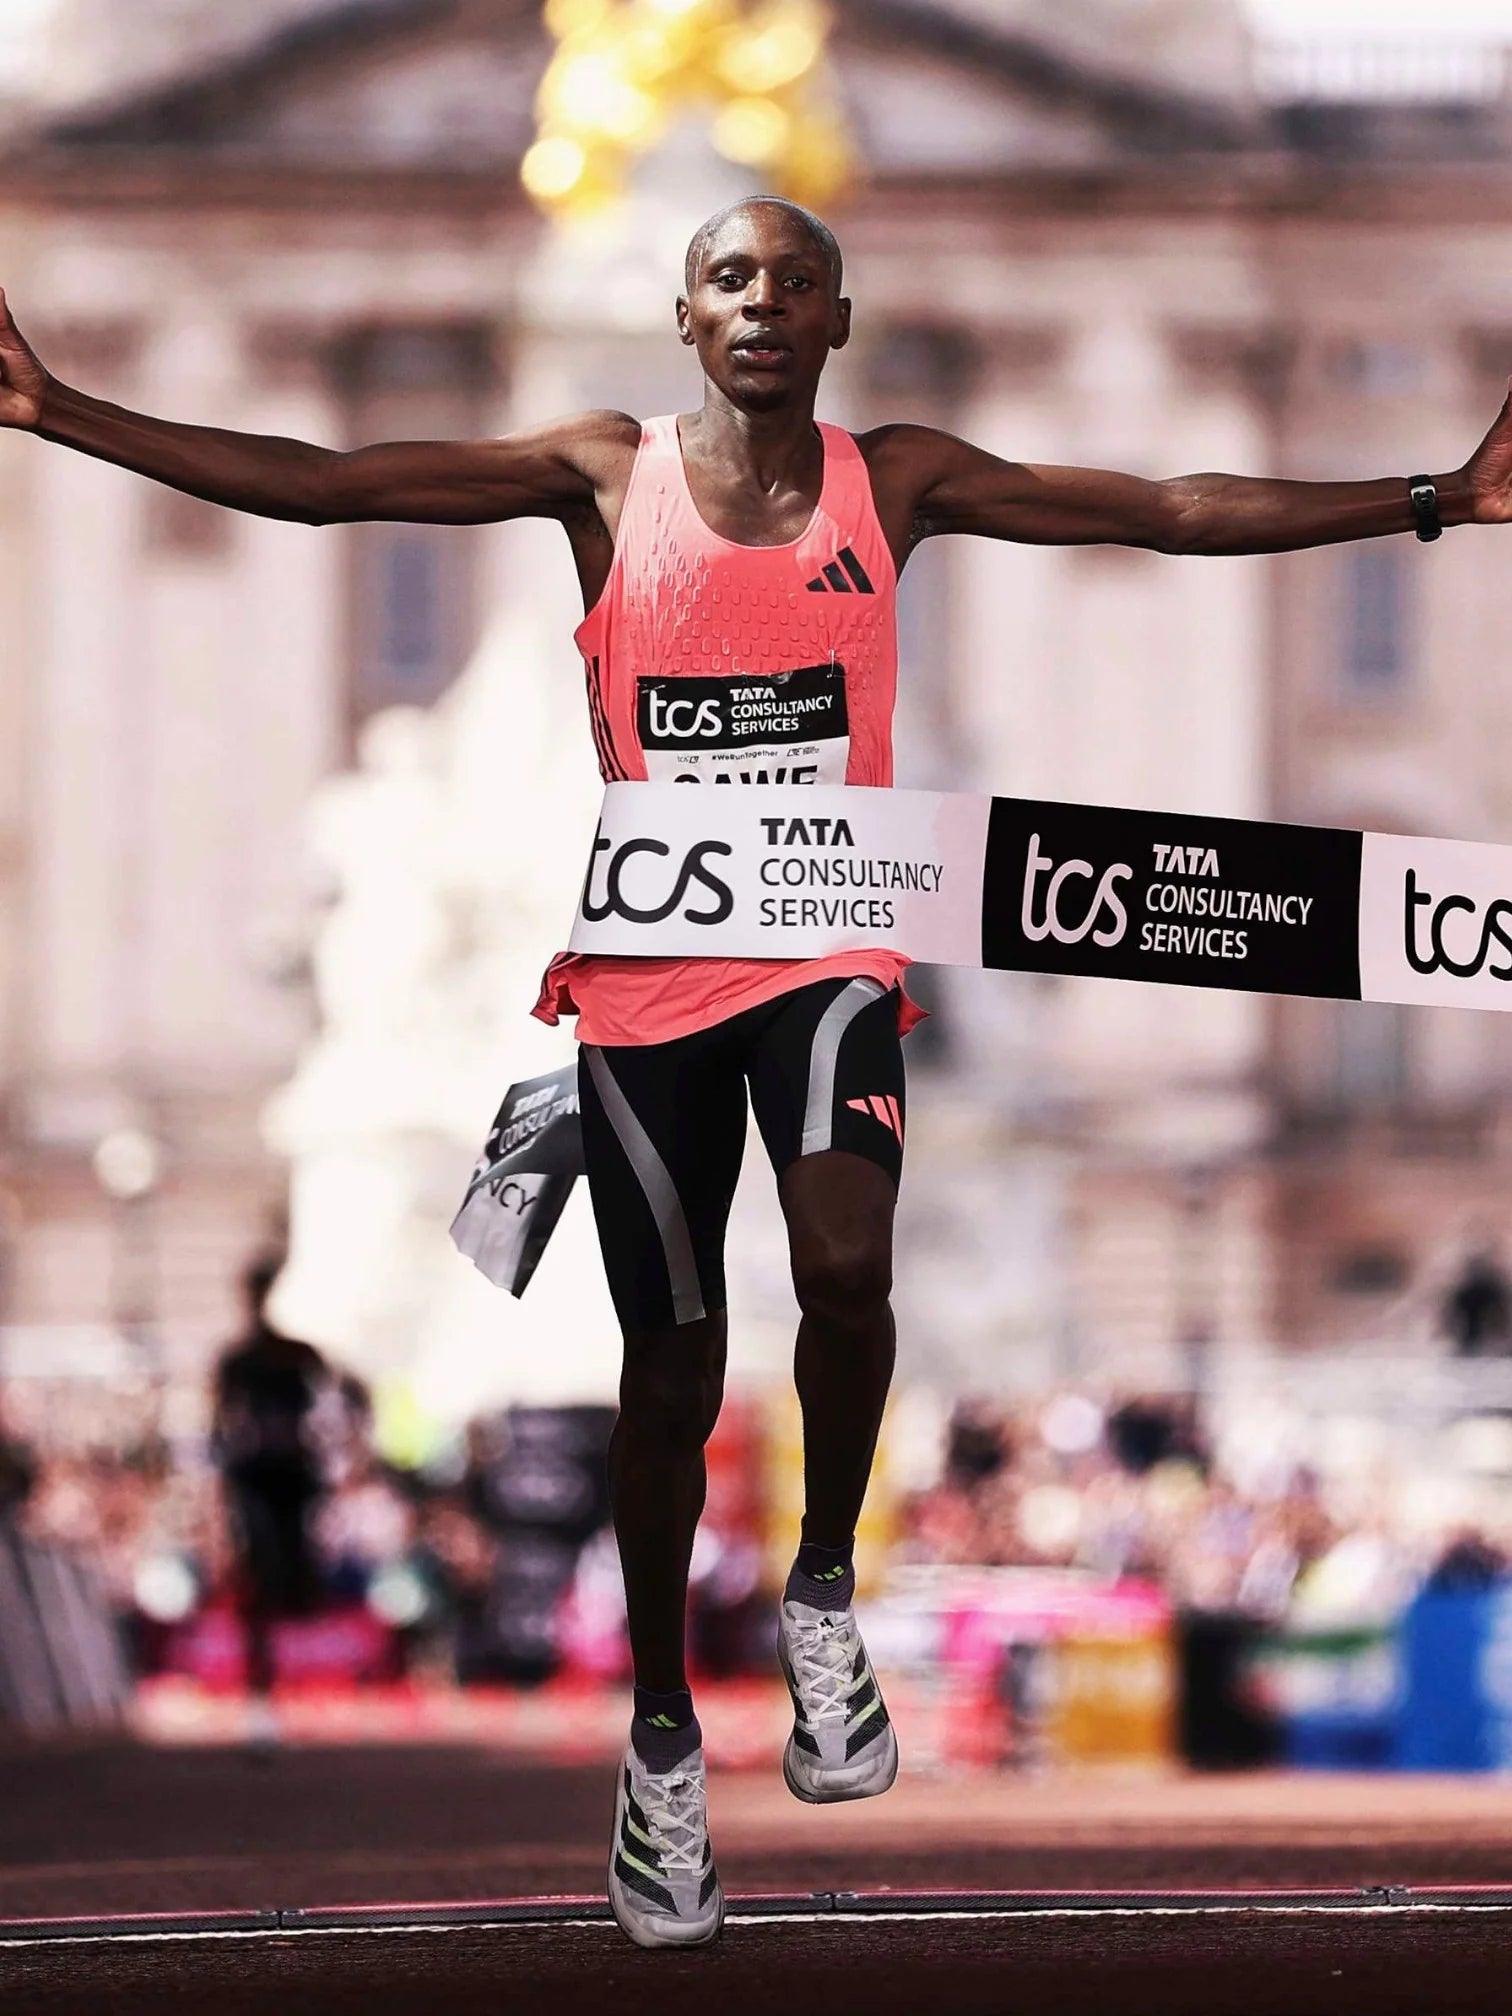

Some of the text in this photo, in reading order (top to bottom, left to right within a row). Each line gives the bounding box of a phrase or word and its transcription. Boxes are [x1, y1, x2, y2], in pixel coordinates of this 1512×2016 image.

[729, 687, 777, 701] TATA
[731, 695, 833, 719] CONSULTANCY
[650, 689, 722, 737] tcs
[732, 717, 799, 736] SERVICES
[759, 818, 855, 847] TATA
[760, 857, 943, 893] CONSULTANCY
[1152, 843, 1220, 878] TATA
[1022, 832, 1133, 947] tcs
[1145, 883, 1313, 926] CONSULTANCY
[759, 898, 895, 929] SERVICES
[1405, 868, 1512, 981] tcs
[1139, 922, 1248, 960] SERVICES
